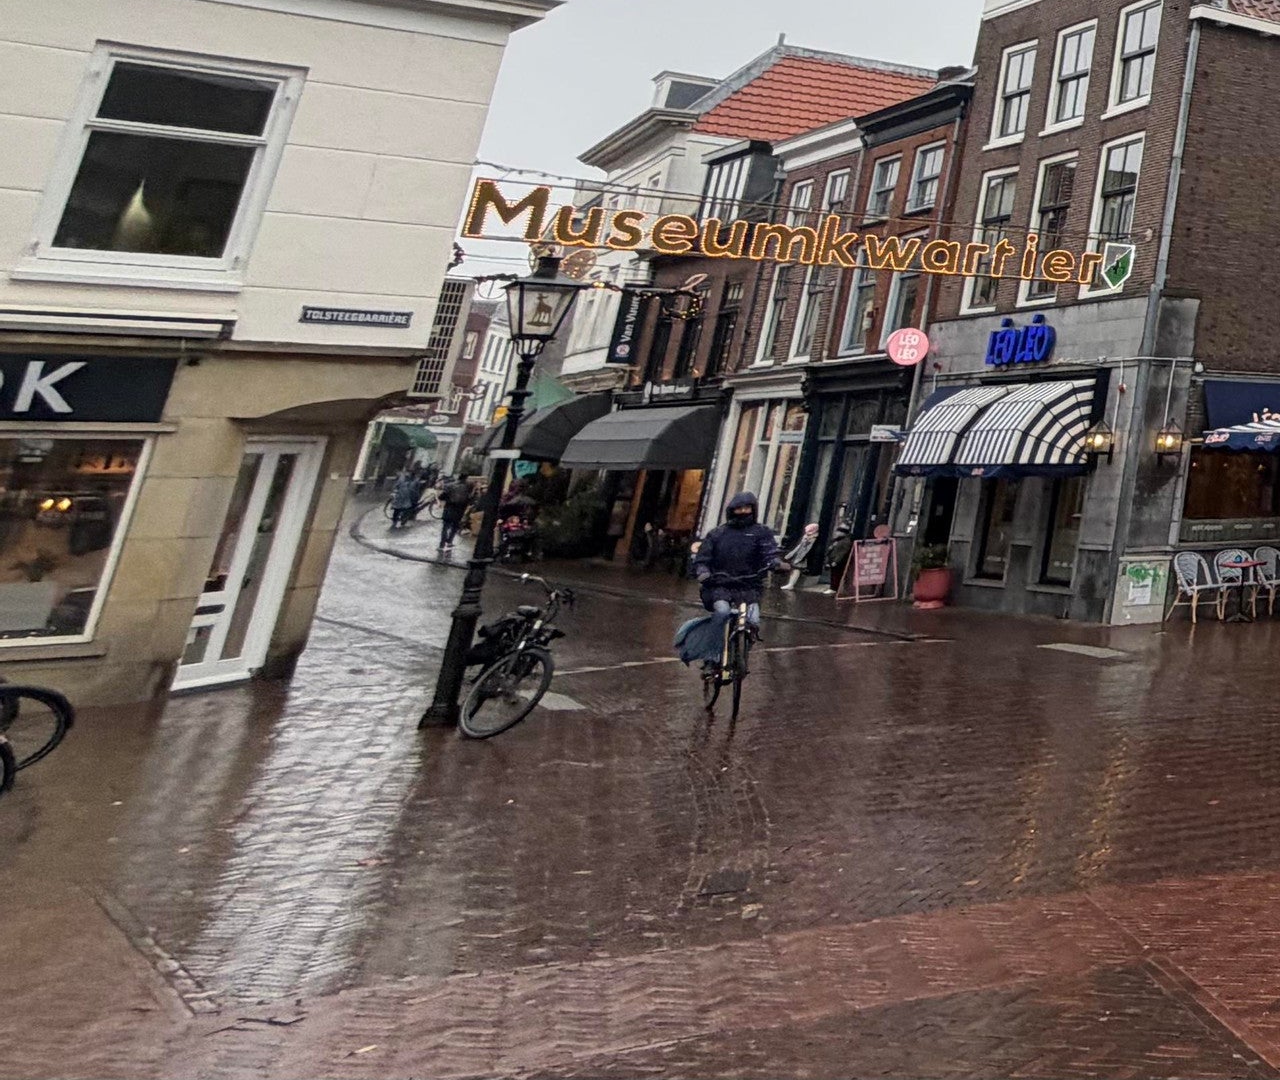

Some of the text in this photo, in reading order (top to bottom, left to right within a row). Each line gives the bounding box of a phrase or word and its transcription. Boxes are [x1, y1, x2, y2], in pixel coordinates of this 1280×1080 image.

[460, 177, 1104, 285] Museumkwartier
[305, 309, 409, 325] TOLSTEEGBARRIÈRE
[620, 322, 635, 342] Van
[0, 360, 88, 414] K
